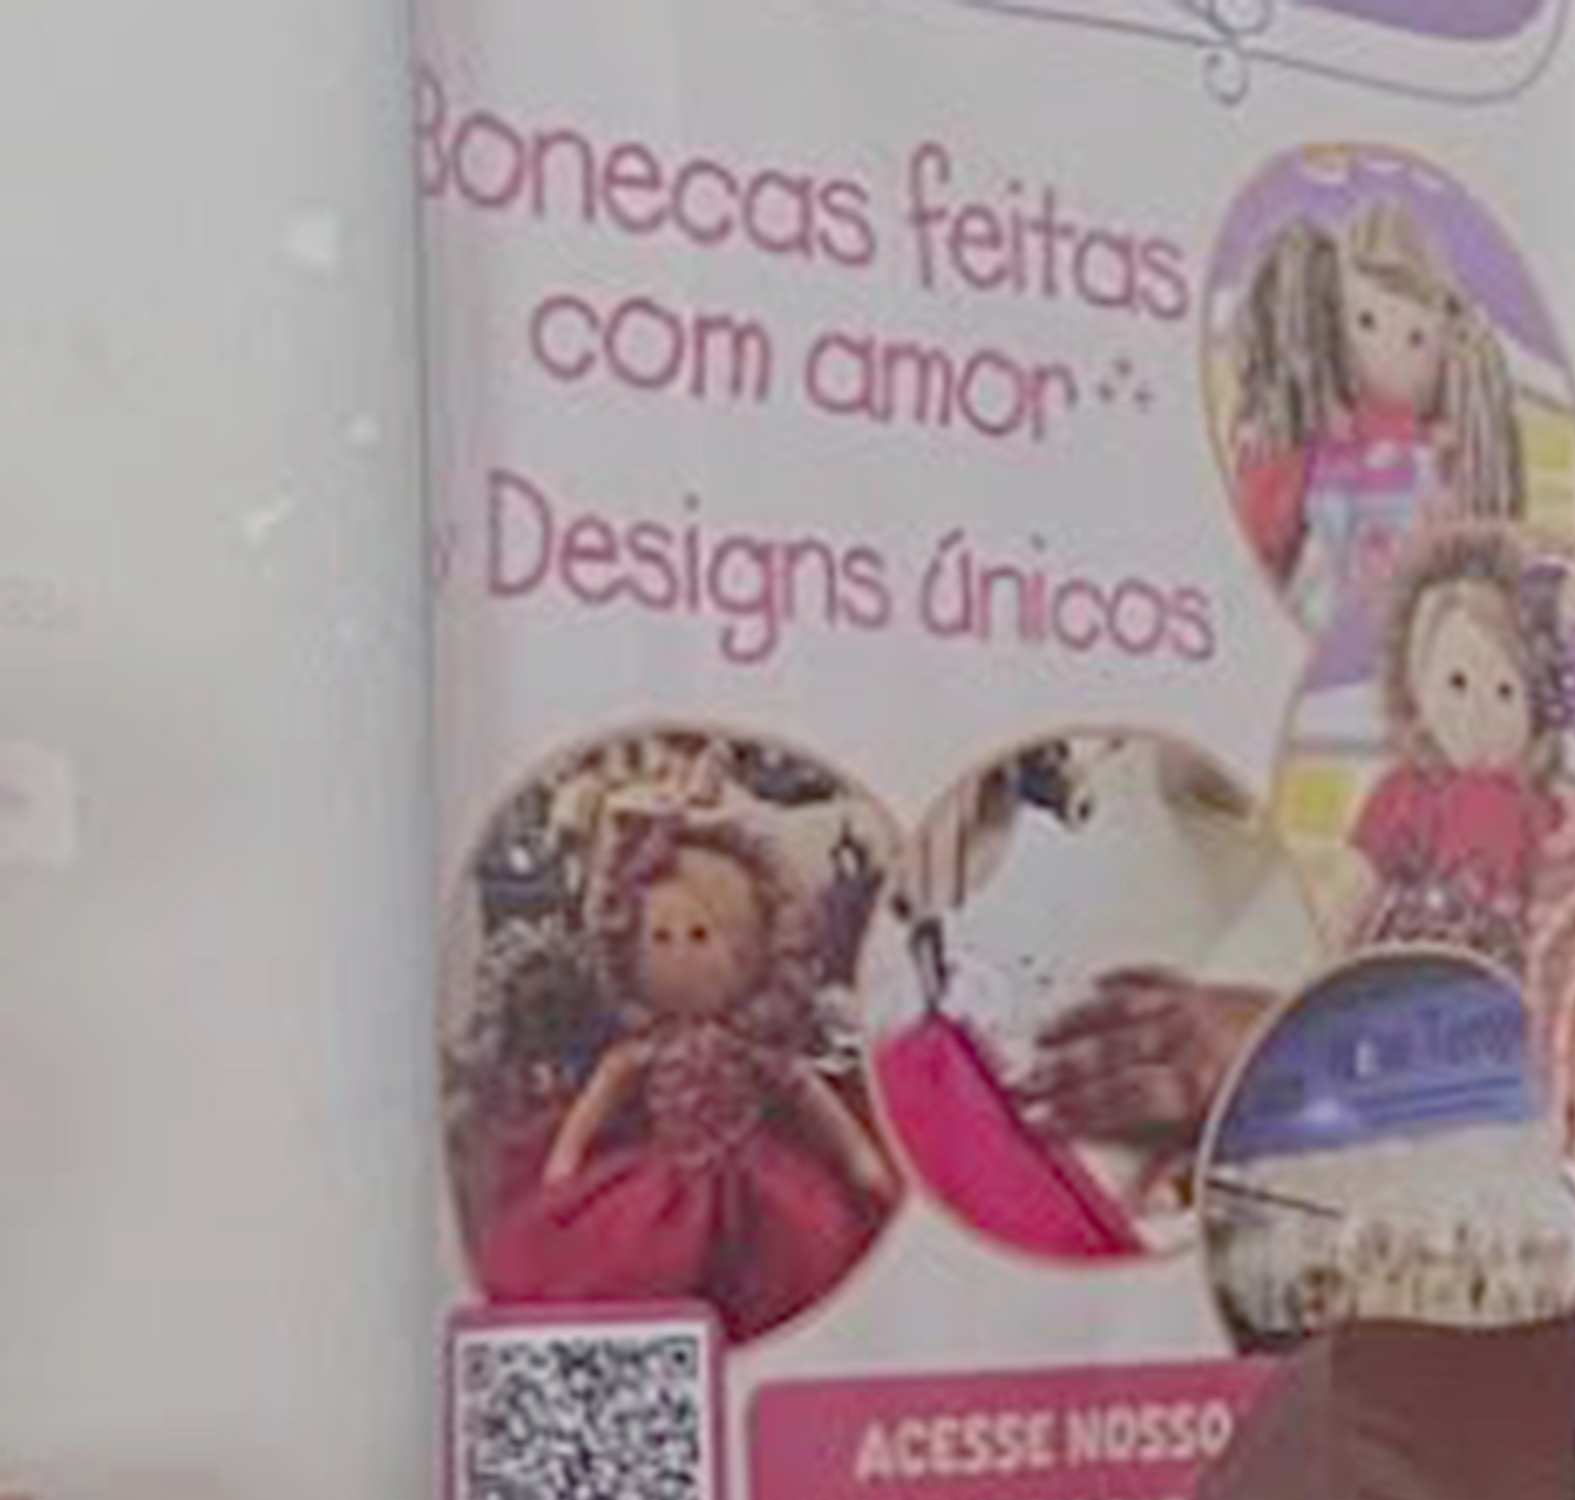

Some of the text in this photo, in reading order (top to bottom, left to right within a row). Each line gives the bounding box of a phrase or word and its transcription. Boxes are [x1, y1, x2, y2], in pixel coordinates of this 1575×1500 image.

[414, 66, 1190, 321] Bonecas feitas
[529, 294, 1080, 442] com amor
[488, 468, 1216, 665] Designs únicos
[853, 1399, 1235, 1484] ACESSE NOSSO
